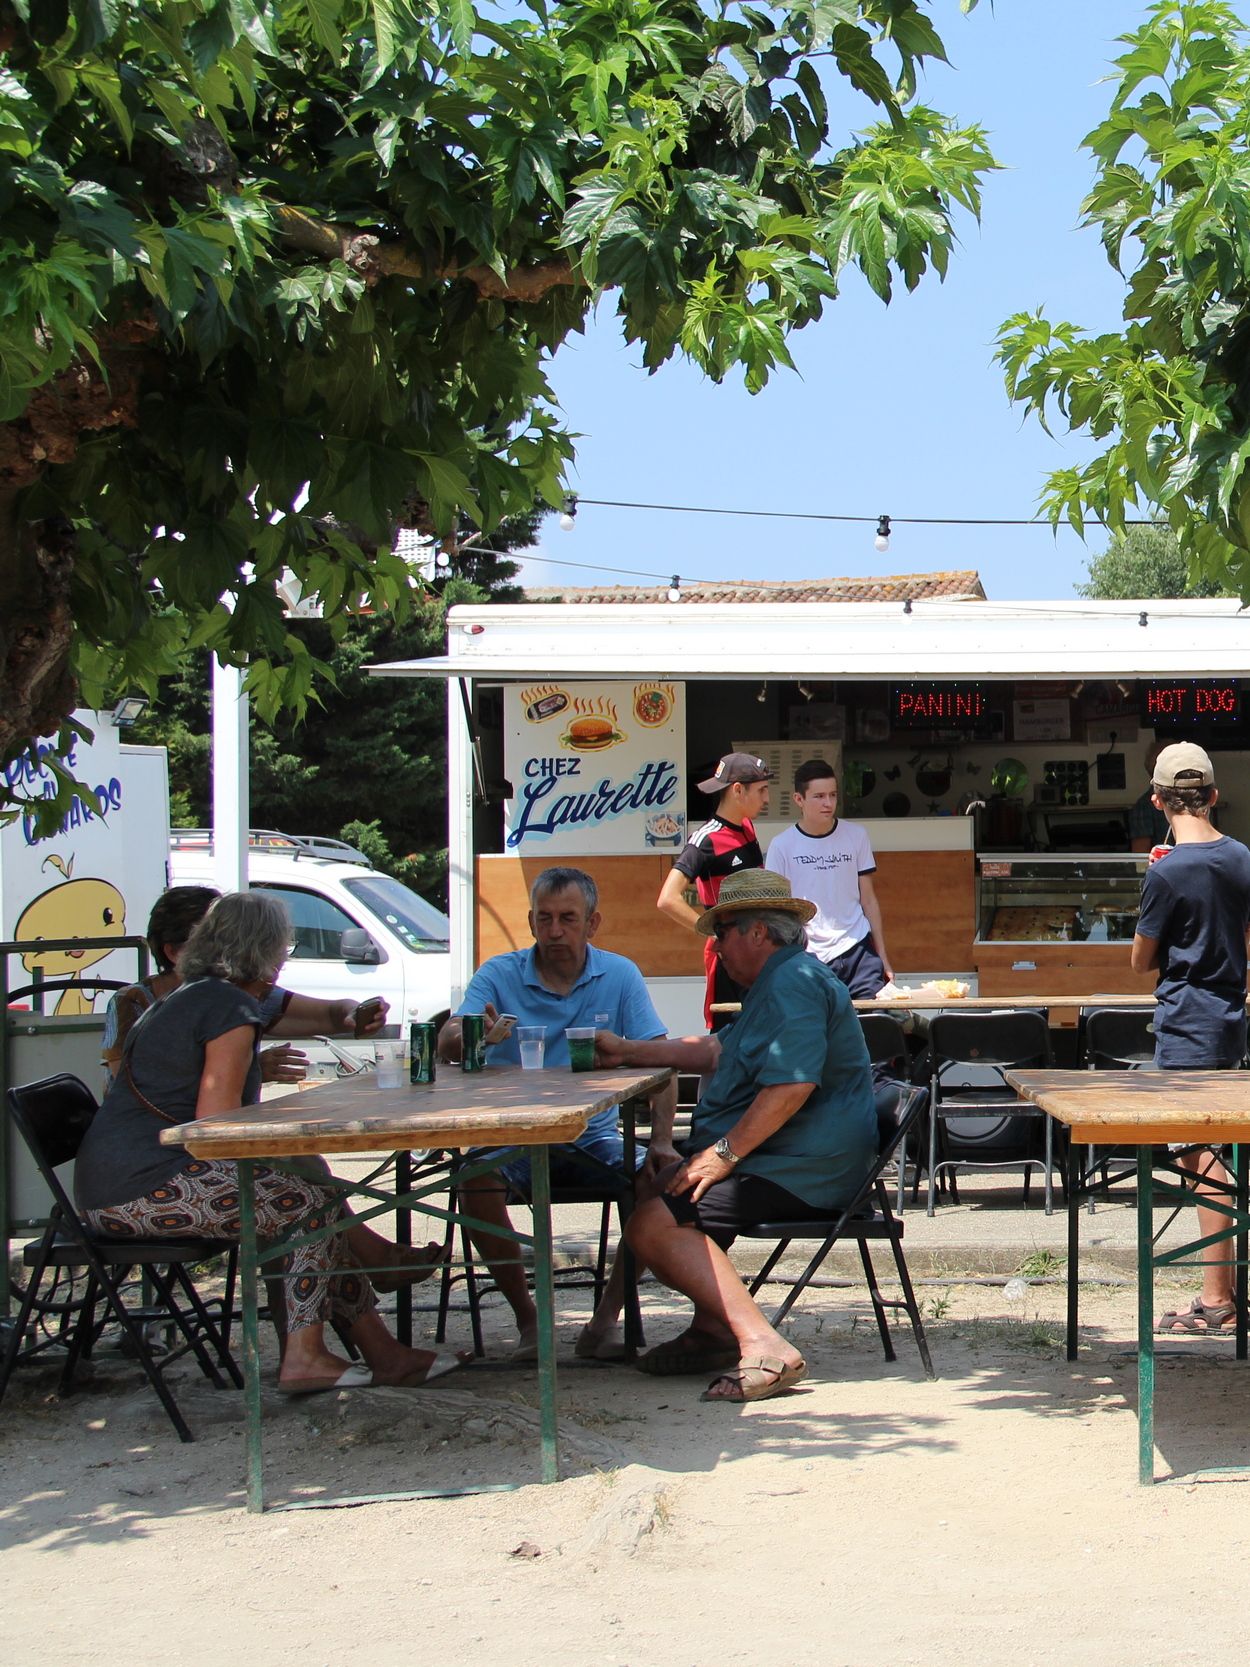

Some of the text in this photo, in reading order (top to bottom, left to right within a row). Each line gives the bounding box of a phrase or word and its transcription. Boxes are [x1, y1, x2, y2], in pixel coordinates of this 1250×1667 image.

[900, 693, 981, 716] PANINI
[1148, 689, 1235, 712] HOT DOG
[1019, 717, 1064, 726] HAMBURGER
[524, 757, 582, 777] CHEZ
[506, 760, 679, 848] Laurette
[792, 855, 825, 866] TEDDY
